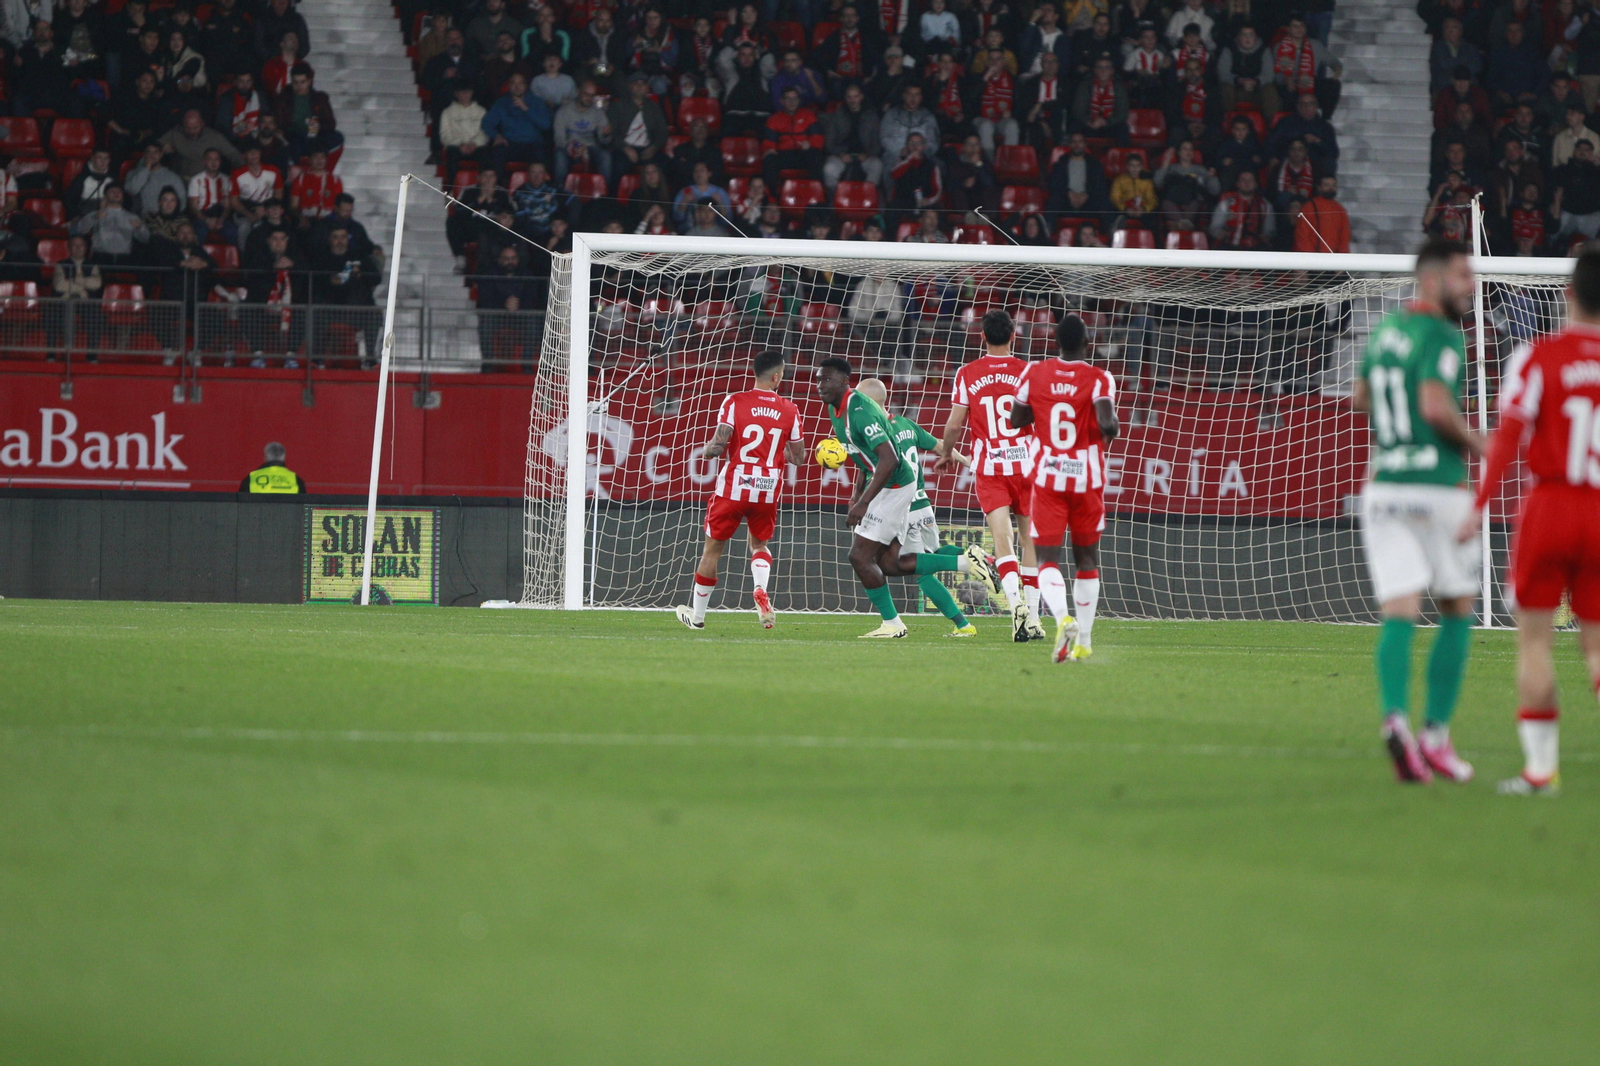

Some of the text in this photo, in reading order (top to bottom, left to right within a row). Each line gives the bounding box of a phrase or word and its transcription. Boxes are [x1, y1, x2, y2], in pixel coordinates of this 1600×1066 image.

[968, 372, 994, 396] MARC
[1050, 382, 1077, 397] LOPY
[750, 406, 782, 421] CHUMI
[979, 394, 1020, 439] 18
[1369, 363, 1413, 448] 11
[864, 421, 883, 437] OK
[1050, 402, 1077, 450] 6
[0, 407, 188, 471] aBank
[739, 423, 783, 467] 21
[1006, 453, 1027, 461] HORSE
[1062, 459, 1084, 468] POWER
[1061, 467, 1084, 476] HORSE
[321, 554, 421, 578] DE CBRAS
